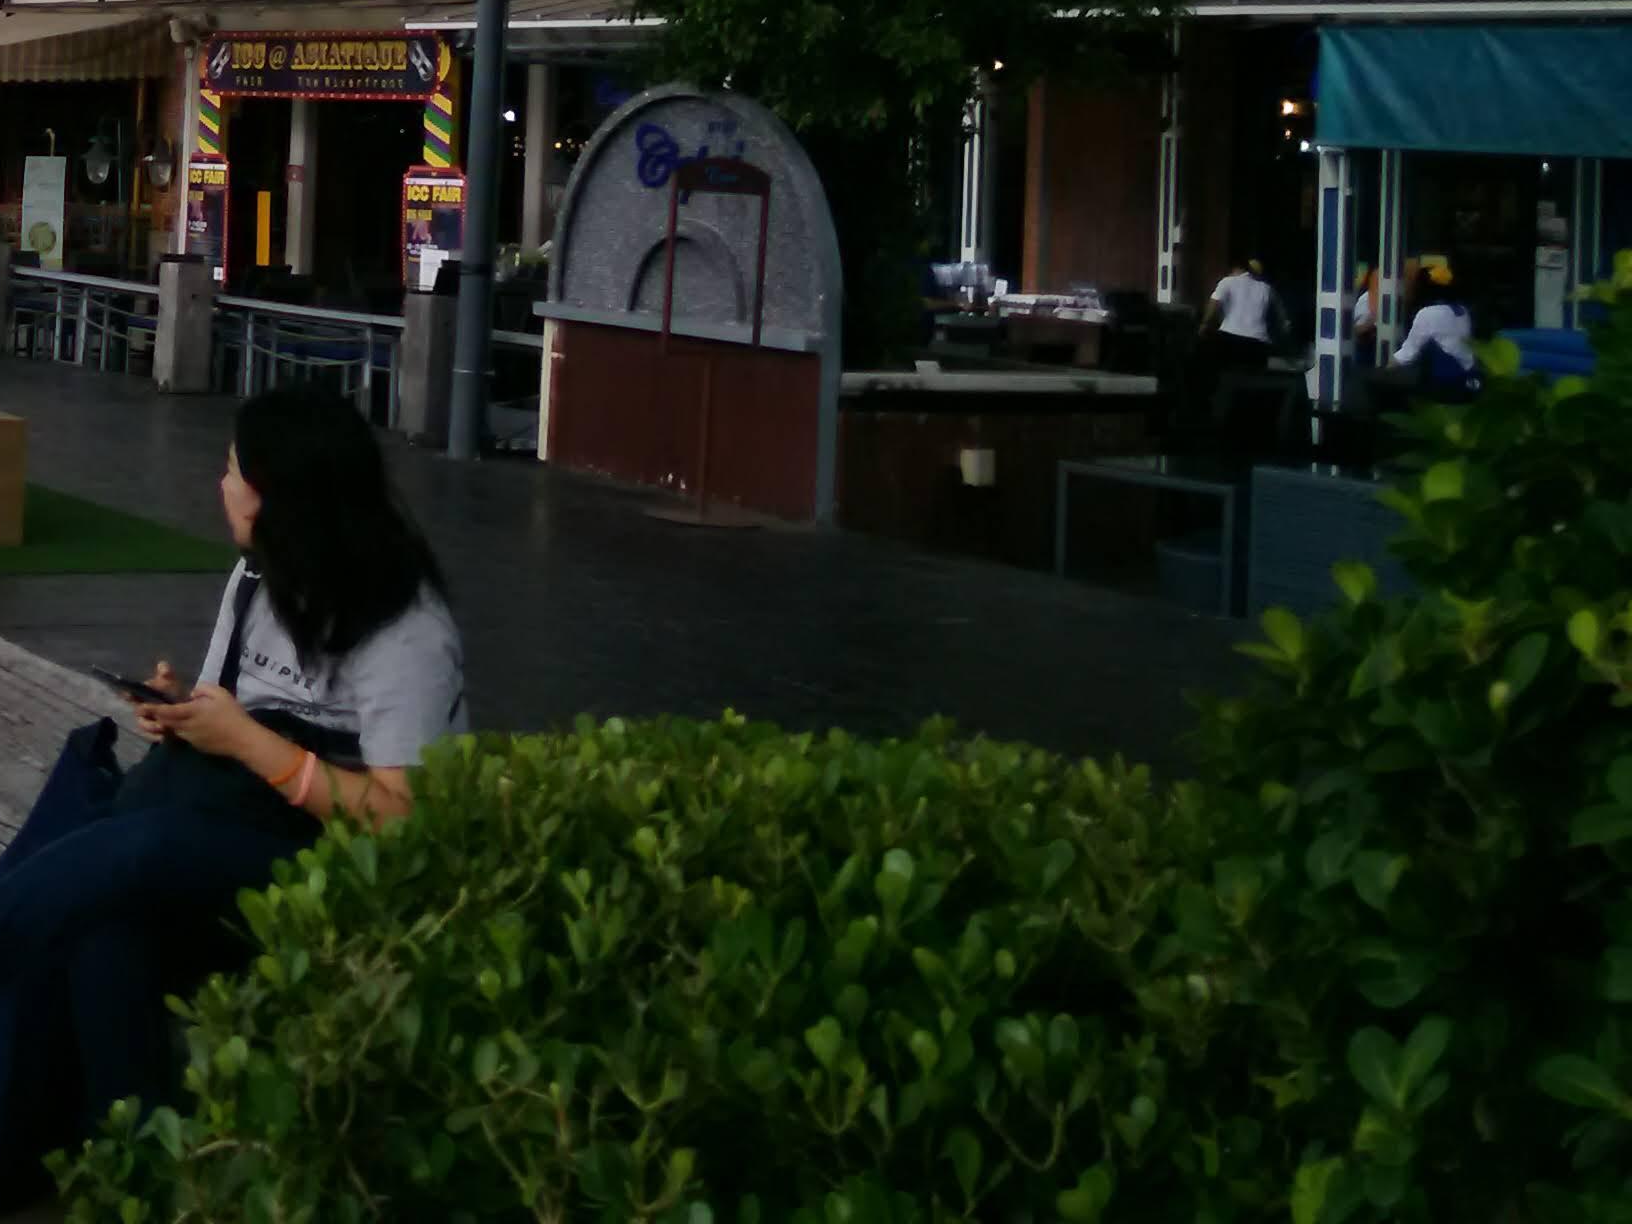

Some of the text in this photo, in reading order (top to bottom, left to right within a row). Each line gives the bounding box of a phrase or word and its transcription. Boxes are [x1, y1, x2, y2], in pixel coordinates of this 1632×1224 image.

[231, 41, 407, 71] ICC @ ASIATIQUE
[407, 184, 461, 203] ICC FAIR
